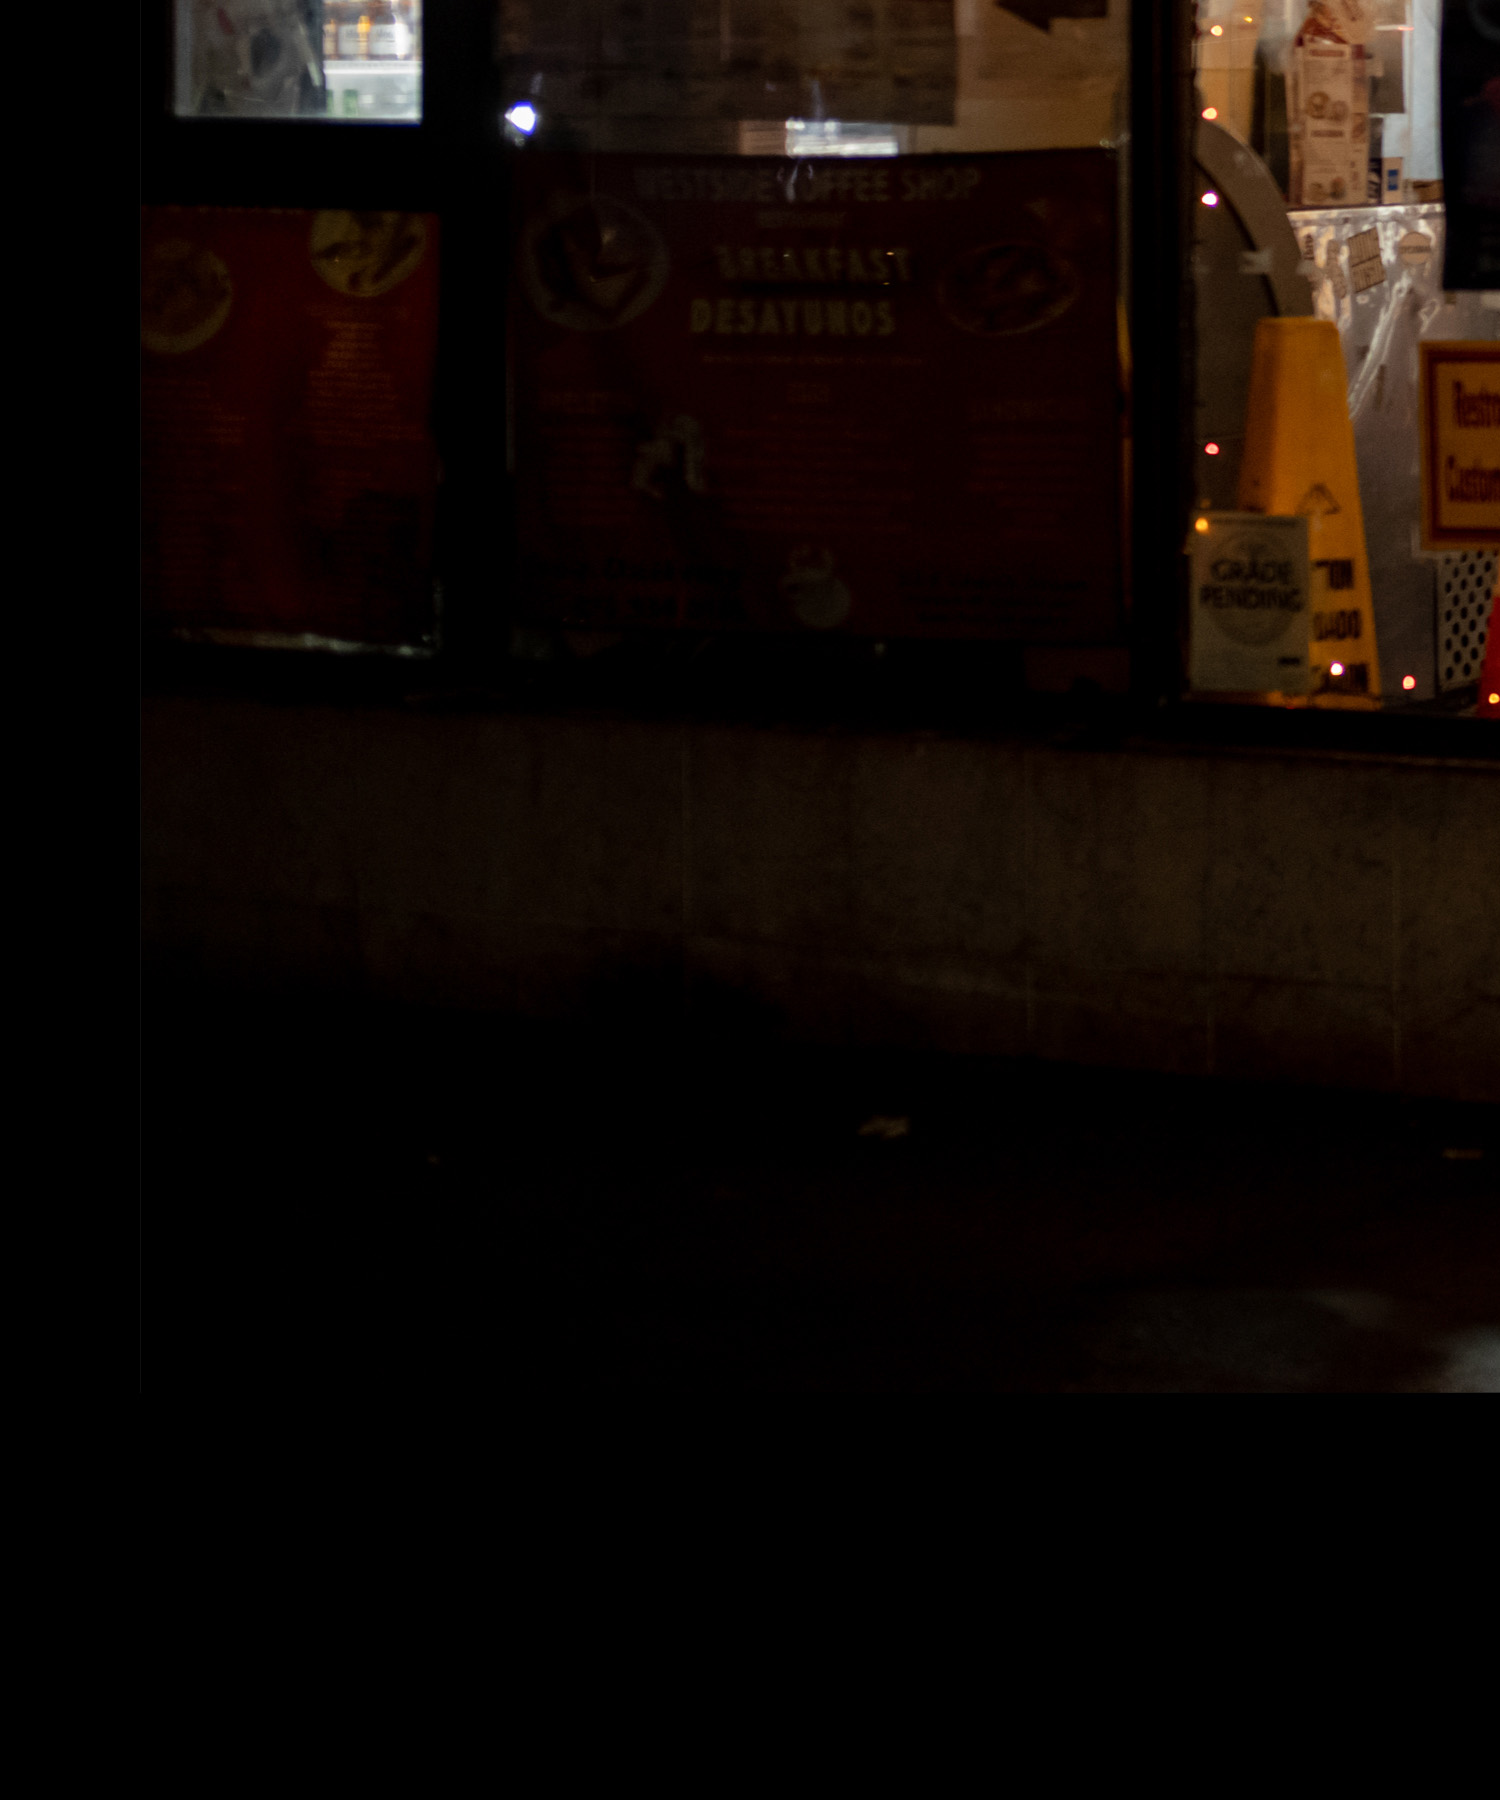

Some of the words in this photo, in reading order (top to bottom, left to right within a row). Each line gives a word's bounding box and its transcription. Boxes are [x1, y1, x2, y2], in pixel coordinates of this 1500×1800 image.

[900, 166, 982, 202] SHOP
[713, 244, 912, 282] BREAKFAST
[689, 298, 897, 336] DESAYUNOS
[1200, 582, 1305, 613] PENDING
